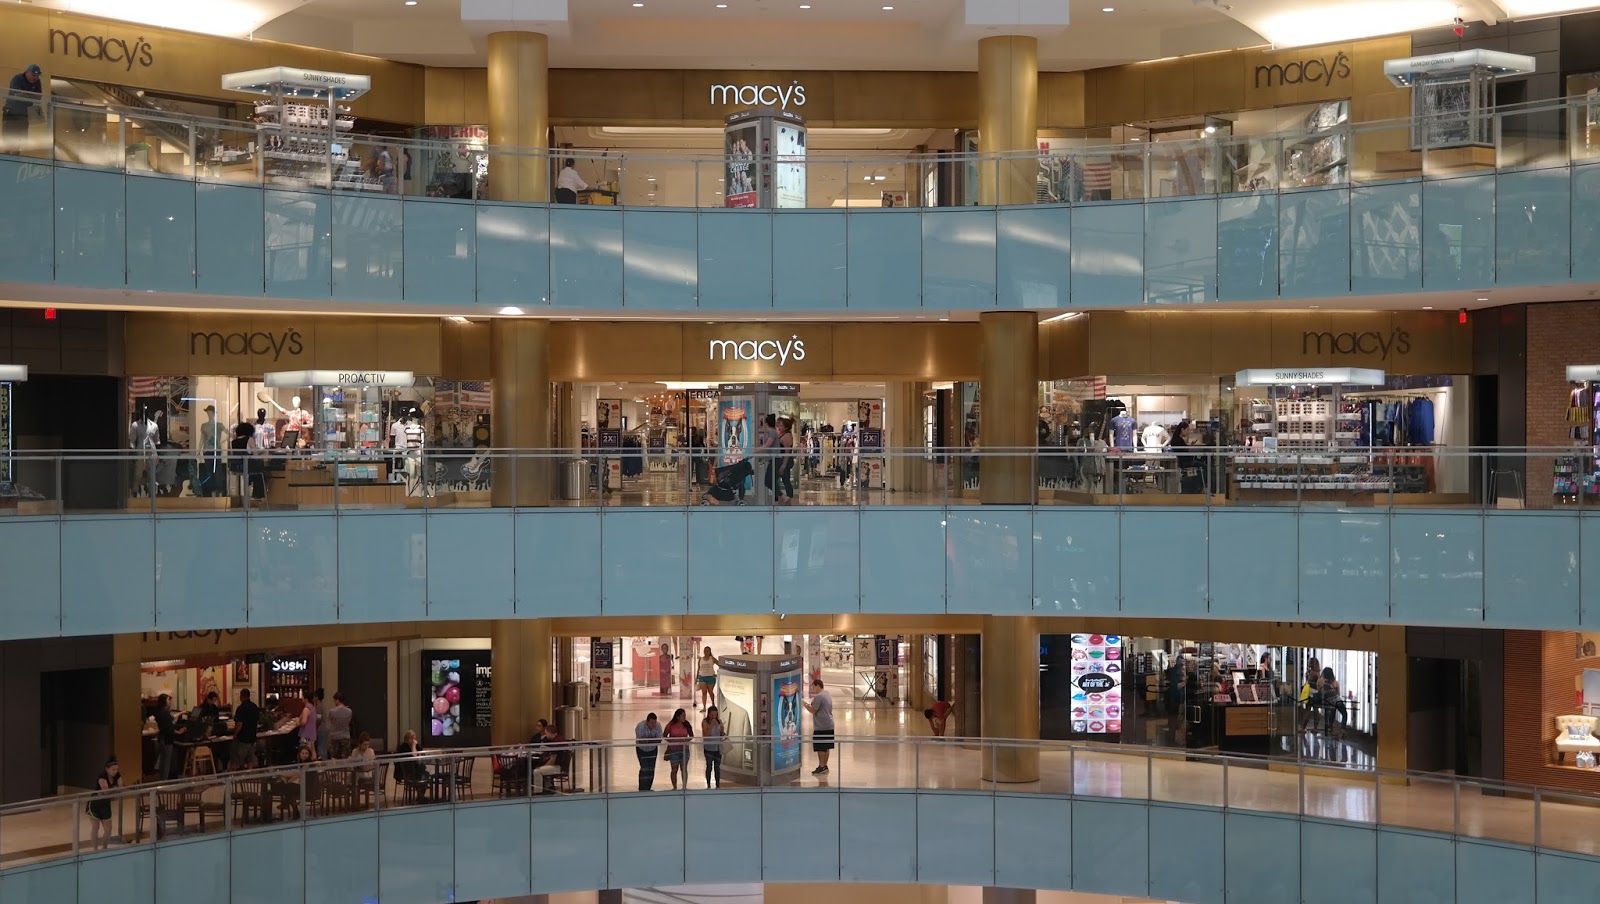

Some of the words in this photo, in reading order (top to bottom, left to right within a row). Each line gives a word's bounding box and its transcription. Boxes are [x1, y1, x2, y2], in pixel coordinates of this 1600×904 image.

[49, 28, 153, 72] macy's
[303, 73, 322, 82] SUNNY
[322, 75, 346, 85] SHADES
[1254, 50, 1350, 89] macy's
[710, 79, 806, 110] macy's
[191, 326, 303, 362] macy's
[709, 334, 805, 366] macy's
[1302, 326, 1411, 361] macy's
[338, 373, 386, 384] PROACTIV
[1275, 372, 1298, 380] SUNNY
[1298, 371, 1324, 380] SHADES
[271, 659, 308, 672] Sushi
